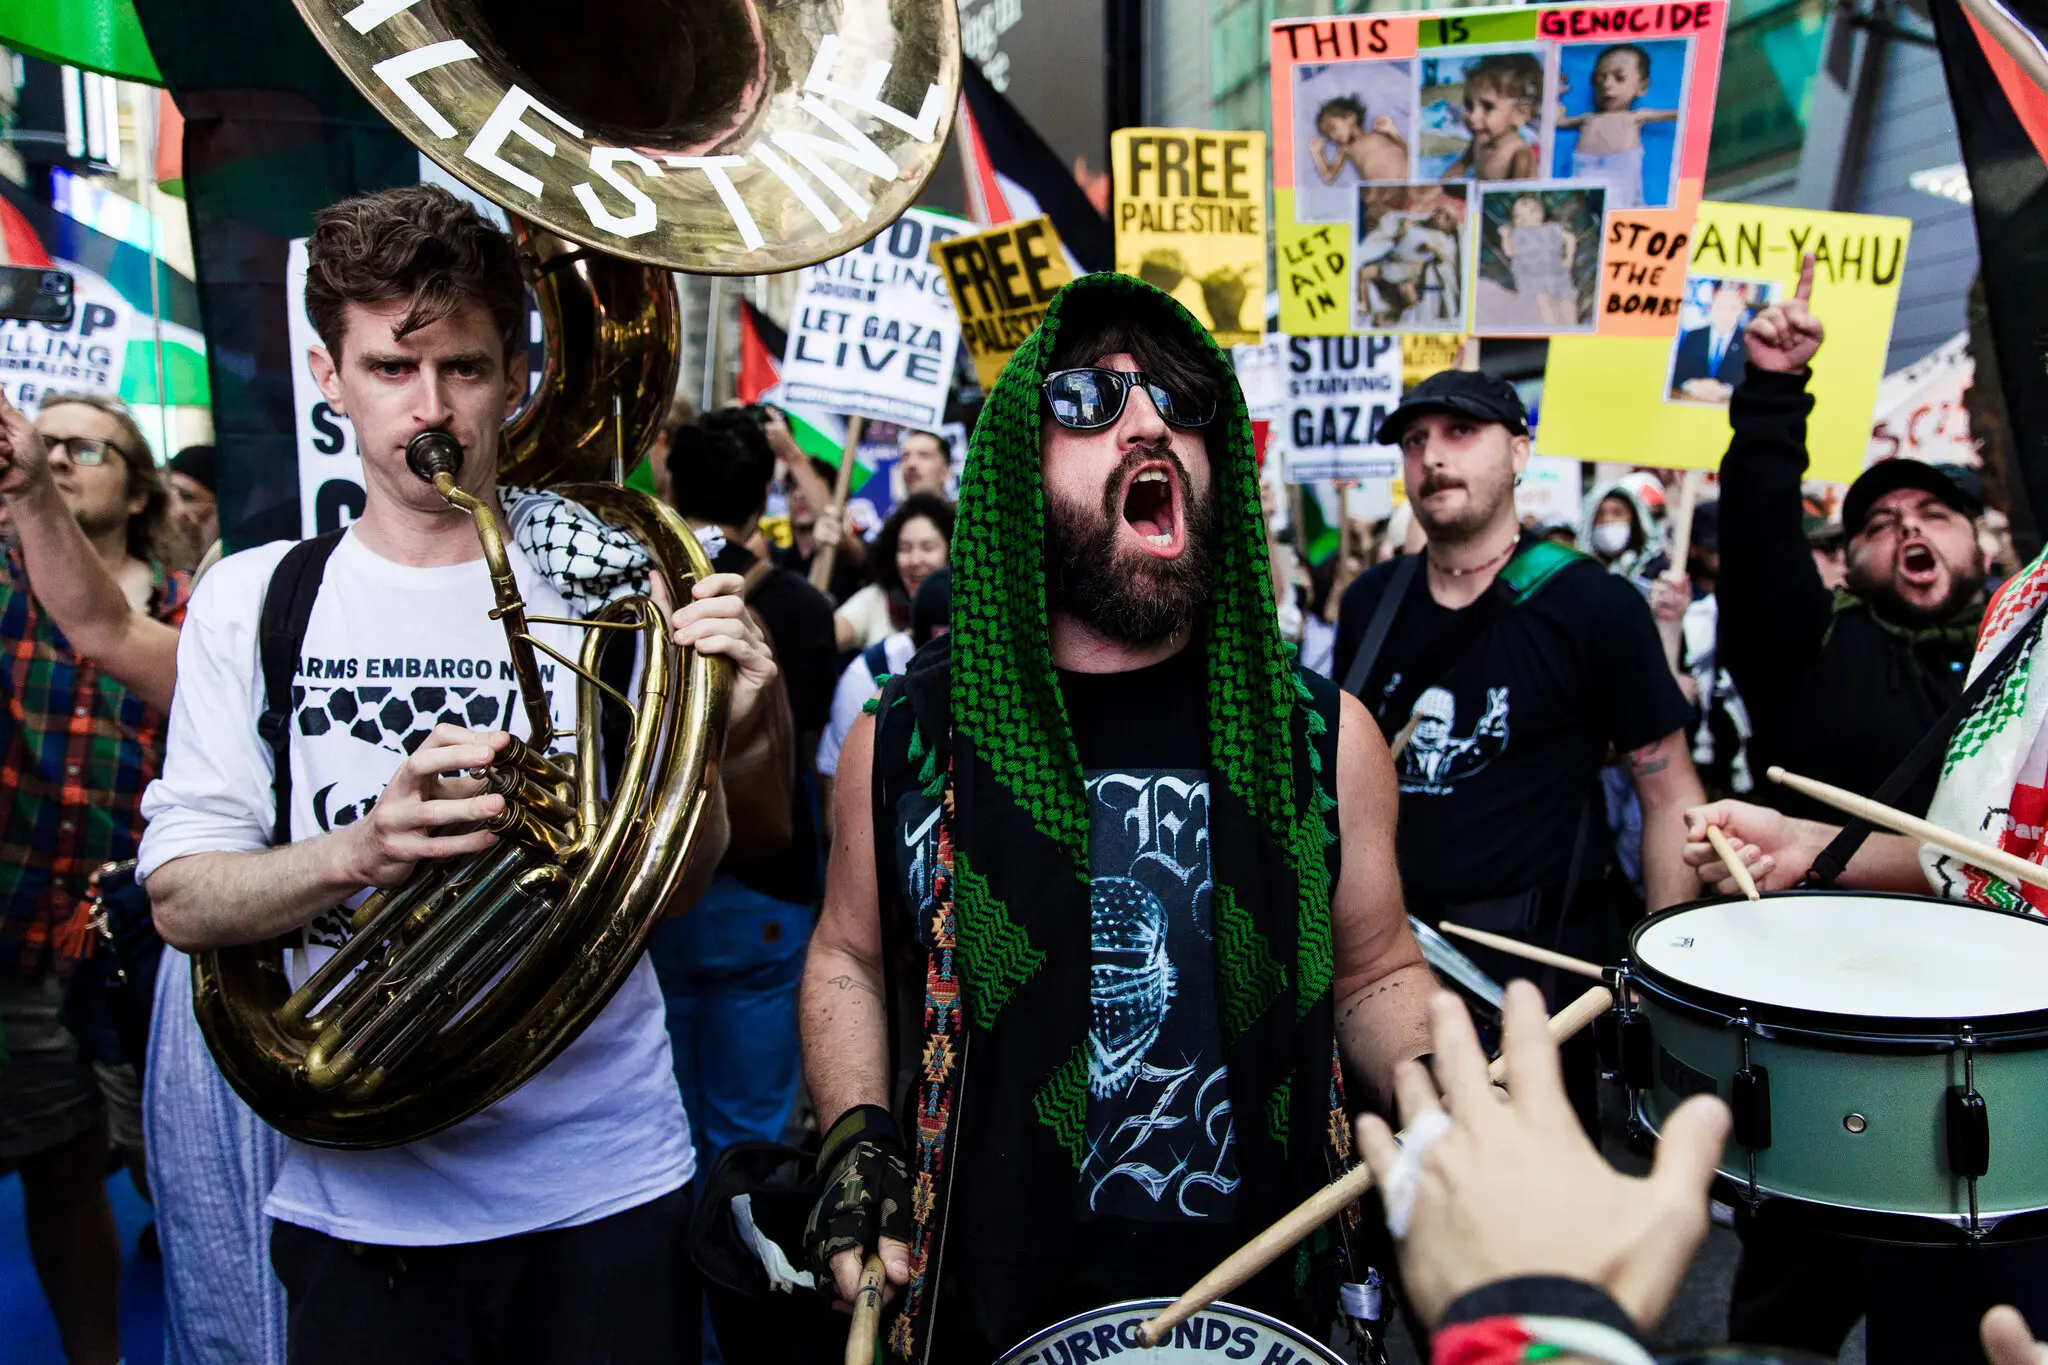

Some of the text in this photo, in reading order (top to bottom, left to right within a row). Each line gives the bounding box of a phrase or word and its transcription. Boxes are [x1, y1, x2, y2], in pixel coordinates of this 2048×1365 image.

[1274, 3, 1712, 60] THIS IS GENOCIDE
[1128, 136, 1250, 199] FREE
[1121, 202, 1259, 235] PALESTINE
[1283, 227, 1330, 265] LET
[1609, 221, 1687, 260] STOP
[942, 219, 1063, 317] FREE
[1290, 252, 1345, 297] AID
[1608, 261, 1666, 287] THE
[1305, 291, 1336, 320] IN
[801, 307, 942, 353] LET GAZA
[795, 335, 942, 385] LIVE
[1289, 336, 1391, 373] STOP
[1290, 375, 1392, 396] STARVING
[366, 658, 492, 680] EMBARGO
[500, 660, 556, 683] NW
[1020, 1316, 1259, 1365] URRONDS
